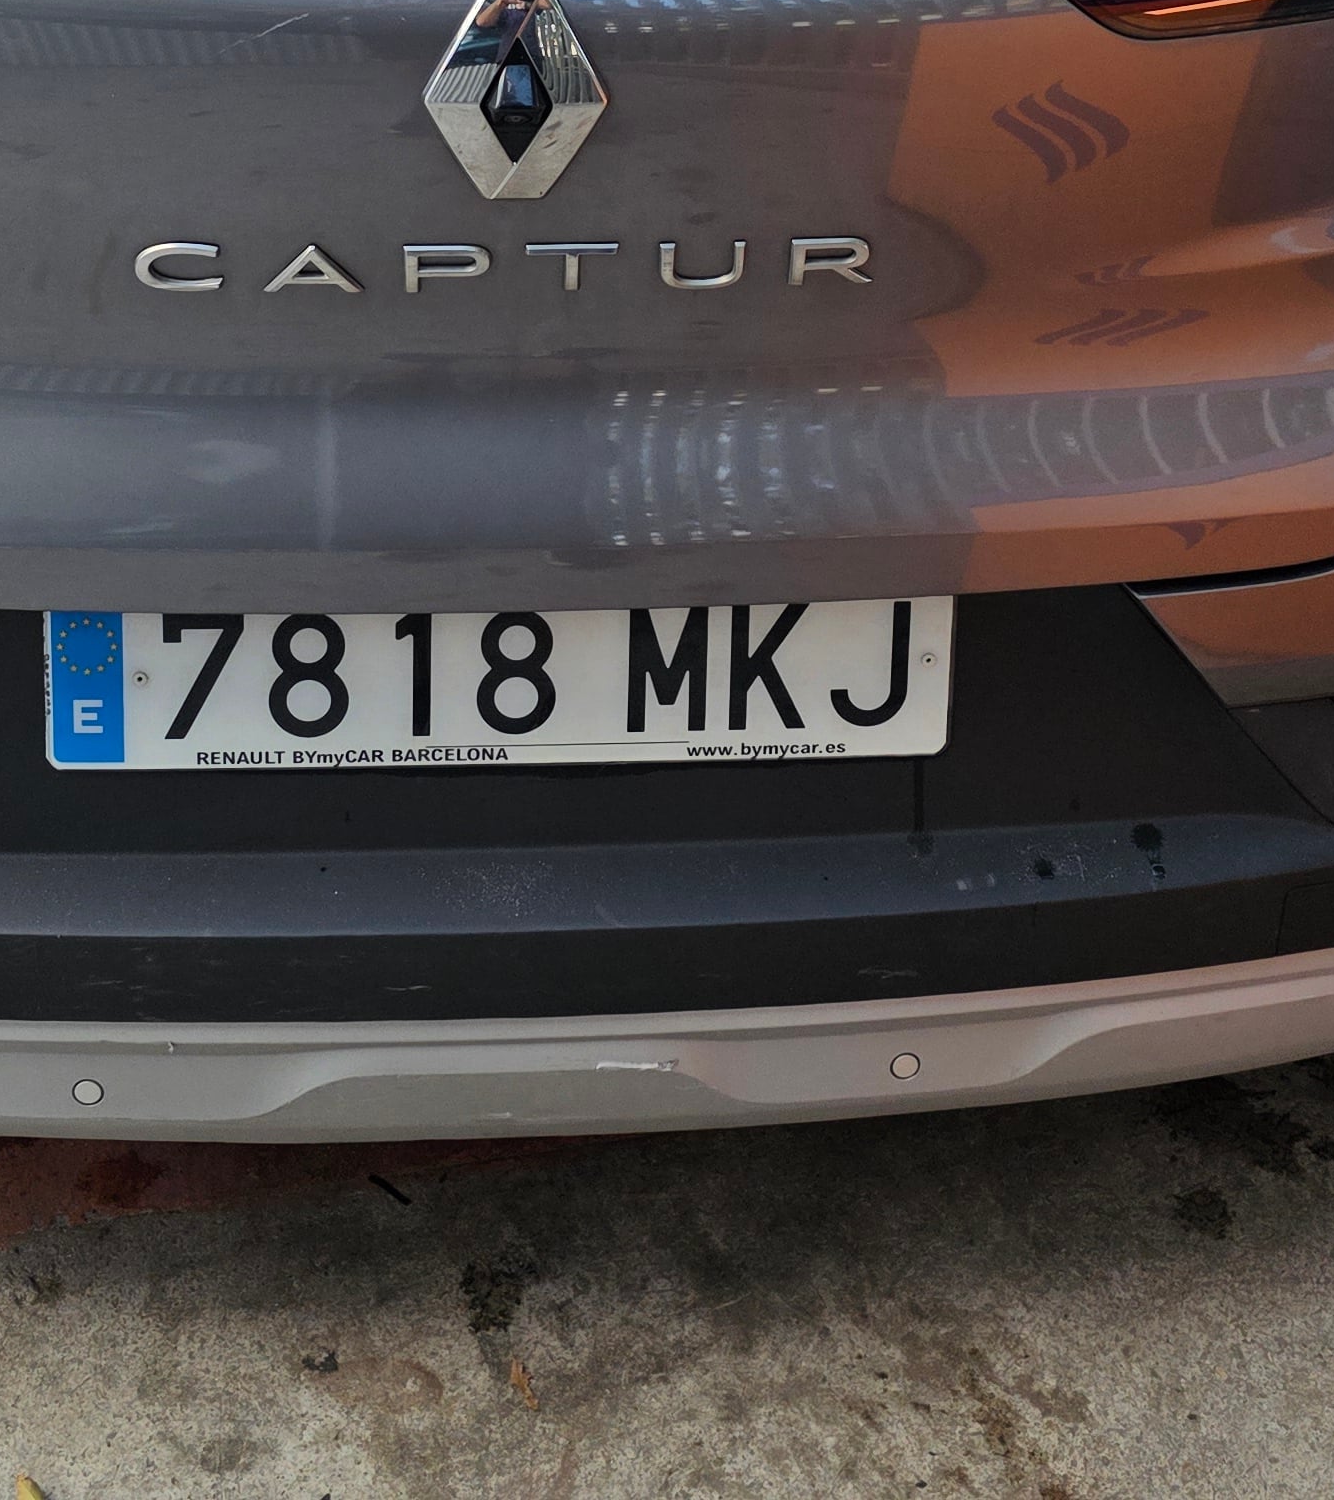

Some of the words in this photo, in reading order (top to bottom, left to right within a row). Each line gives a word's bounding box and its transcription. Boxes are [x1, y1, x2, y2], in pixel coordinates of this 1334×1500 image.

[134, 237, 873, 293] CAPTUR
[162, 611, 557, 740] 7818
[627, 601, 912, 733] MKJ
[72, 699, 104, 734] E
[196, 750, 286, 765] RENAULT
[292, 749, 385, 767] BYmyCAR
[391, 747, 509, 762] BARCELONA
[686, 742, 847, 760] www.bymycar.es
